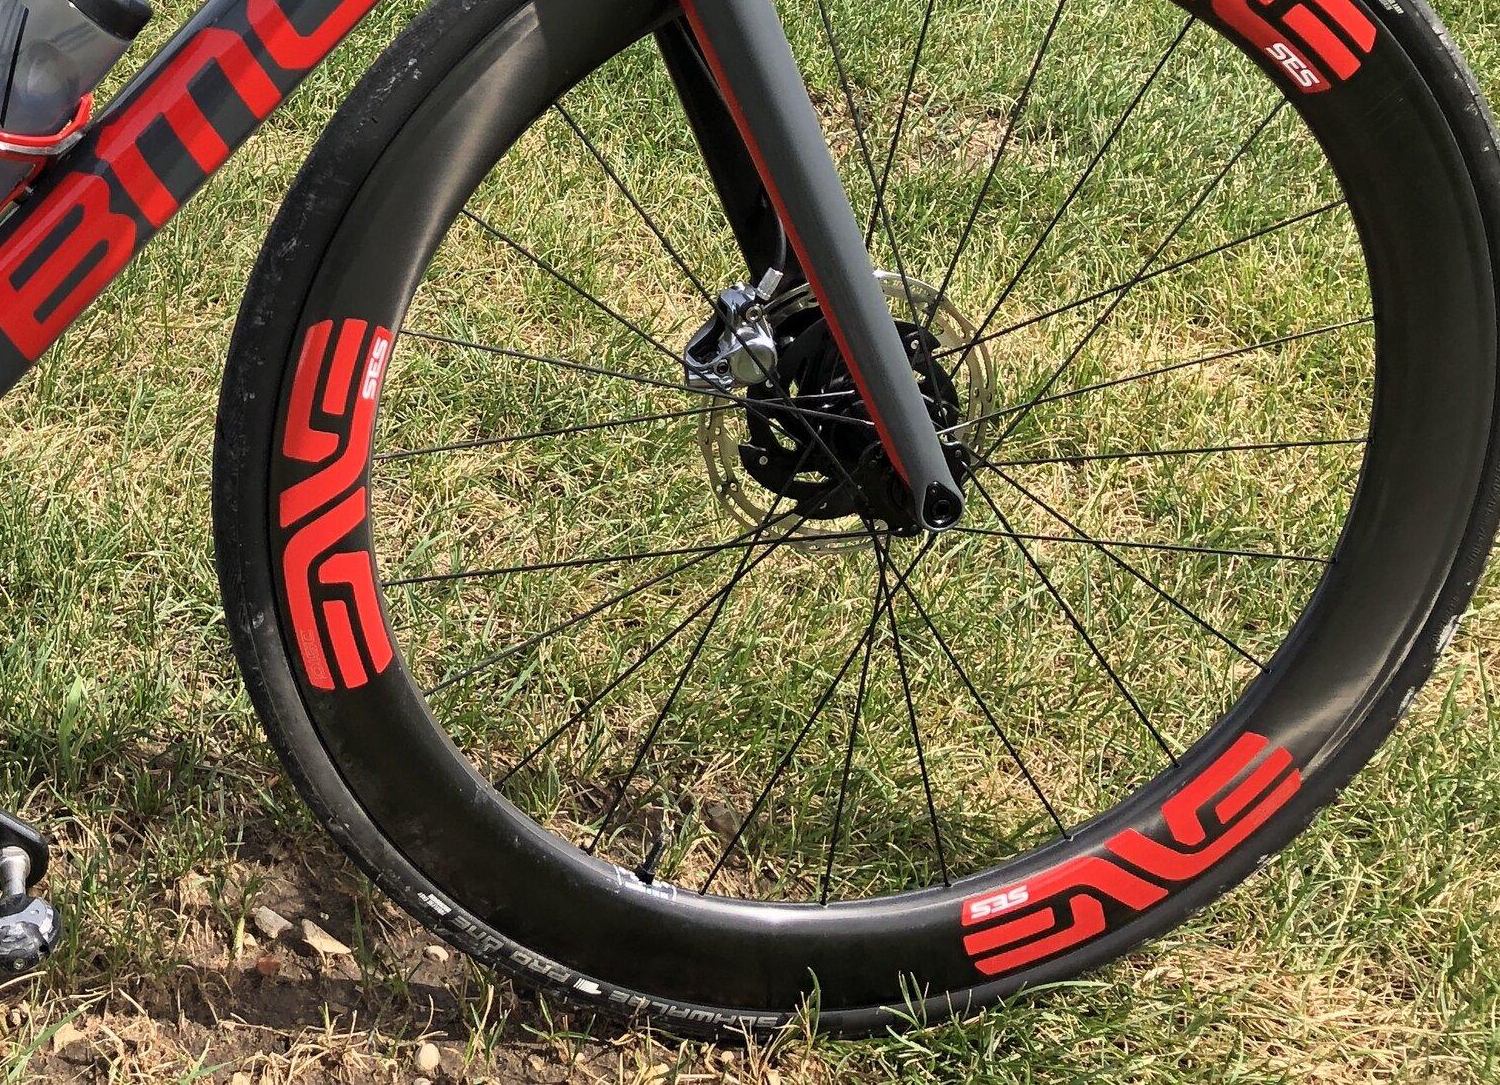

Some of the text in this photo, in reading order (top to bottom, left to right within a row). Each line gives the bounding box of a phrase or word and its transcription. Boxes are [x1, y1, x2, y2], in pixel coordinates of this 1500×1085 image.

[1265, 41, 1321, 88] SES
[361, 336, 389, 401] SES
[280, 318, 393, 690] ENVE
[962, 731, 1302, 976] ENVE
[971, 884, 1030, 920] SES
[451, 915, 779, 1029] SCHWALBE PRO ONE
